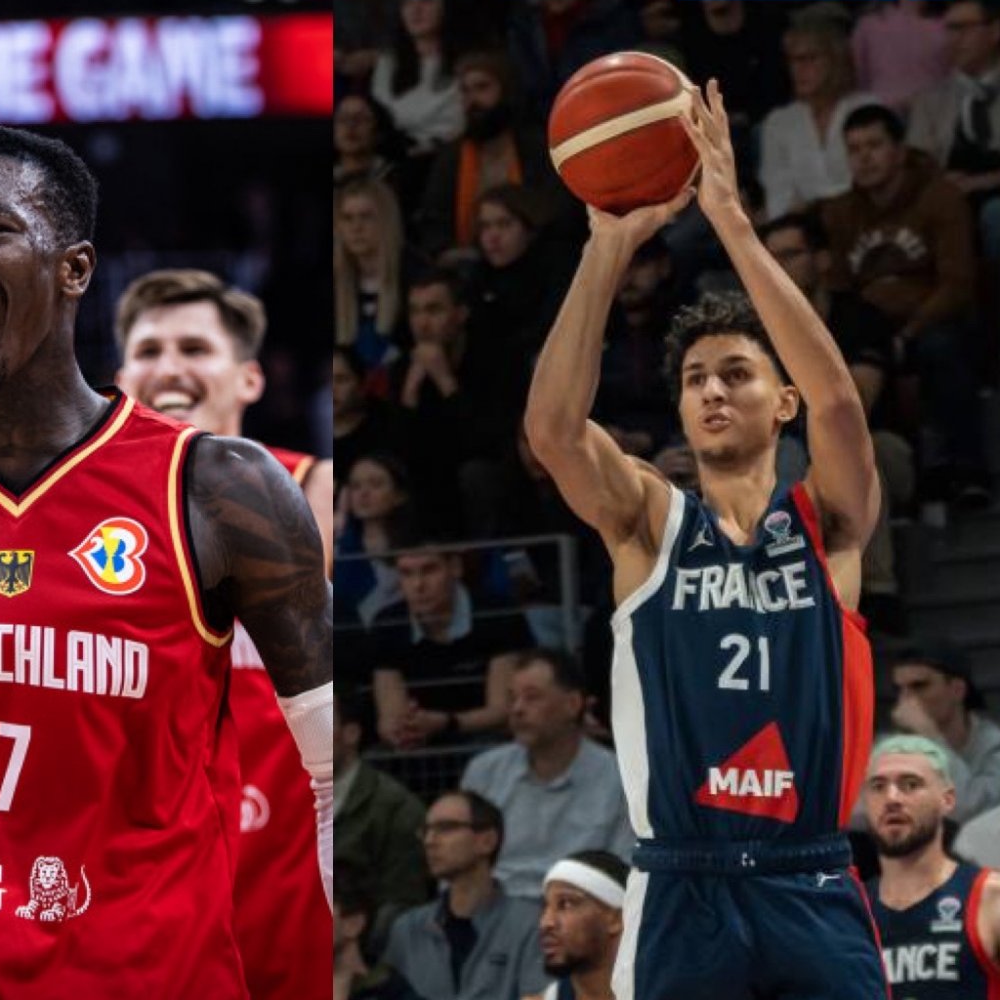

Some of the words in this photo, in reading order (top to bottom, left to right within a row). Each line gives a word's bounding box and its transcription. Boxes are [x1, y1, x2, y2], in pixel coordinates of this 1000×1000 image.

[55, 14, 265, 122] GAME
[718, 633, 770, 691] 21
[707, 767, 795, 797] MAIF
